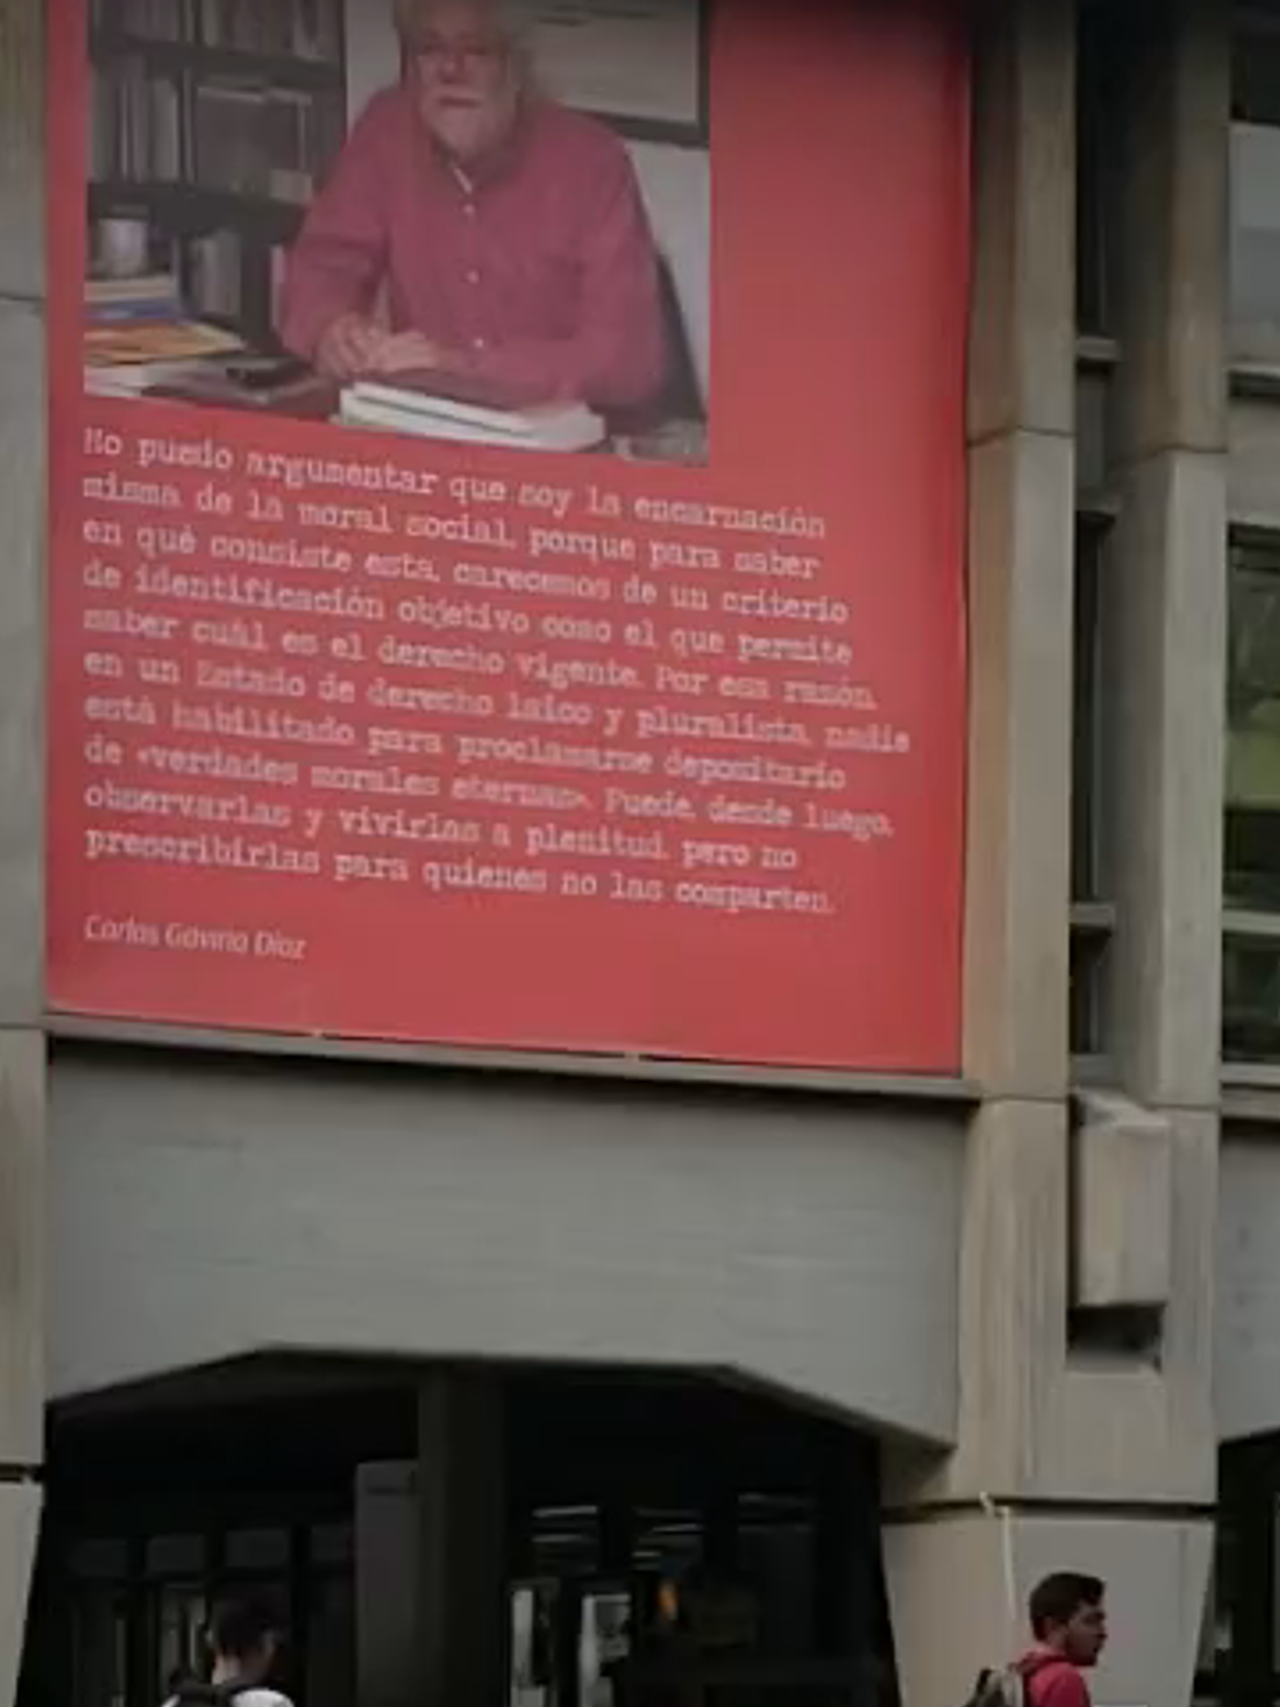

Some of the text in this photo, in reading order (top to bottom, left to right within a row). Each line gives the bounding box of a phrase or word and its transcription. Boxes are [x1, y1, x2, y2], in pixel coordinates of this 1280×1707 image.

[83, 471, 181, 506] misma
[196, 481, 232, 514] de
[246, 489, 283, 520] la
[297, 502, 399, 533] moral
[529, 526, 634, 564] porque
[649, 540, 719, 569] para
[734, 549, 820, 578] saber
[84, 427, 823, 537] No puedo argumentar que soy la encarnación
[83, 519, 122, 546] en
[137, 524, 196, 558] qué
[210, 536, 351, 572] consiste
[623, 573, 656, 604] de
[670, 585, 708, 609] un
[722, 588, 847, 623] criterio
[83, 558, 120, 588] de
[135, 563, 383, 619] identificación
[397, 595, 528, 633] objetivo
[624, 618, 657, 648] el
[670, 628, 723, 657] que
[736, 633, 851, 665] permite
[84, 607, 179, 638] saber
[191, 619, 267, 650] cuál
[281, 631, 318, 654] es
[329, 632, 366, 660] el
[377, 635, 505, 673] derecho
[656, 664, 709, 694] Por
[84, 652, 122, 676] en
[138, 659, 179, 683] un
[197, 660, 306, 696] Estado
[318, 672, 354, 702] de
[366, 677, 493, 715] derecho
[506, 691, 591, 724] laico
[603, 708, 623, 736] y
[825, 724, 908, 752] nadie
[84, 695, 155, 723] está
[366, 727, 442, 755] para
[84, 734, 122, 764] de
[311, 766, 439, 795] morales
[707, 794, 792, 825] desde
[84, 779, 290, 826] observarlas
[304, 808, 324, 838] y
[337, 806, 480, 841] vivirlas
[492, 823, 510, 846] a
[681, 840, 751, 868] pero
[761, 846, 798, 868] no
[85, 829, 319, 872] prescribirlas
[333, 852, 408, 881] para
[423, 856, 546, 891] quienes
[561, 872, 596, 894] no
[610, 870, 663, 901] las
[84, 914, 158, 944] Carlos
